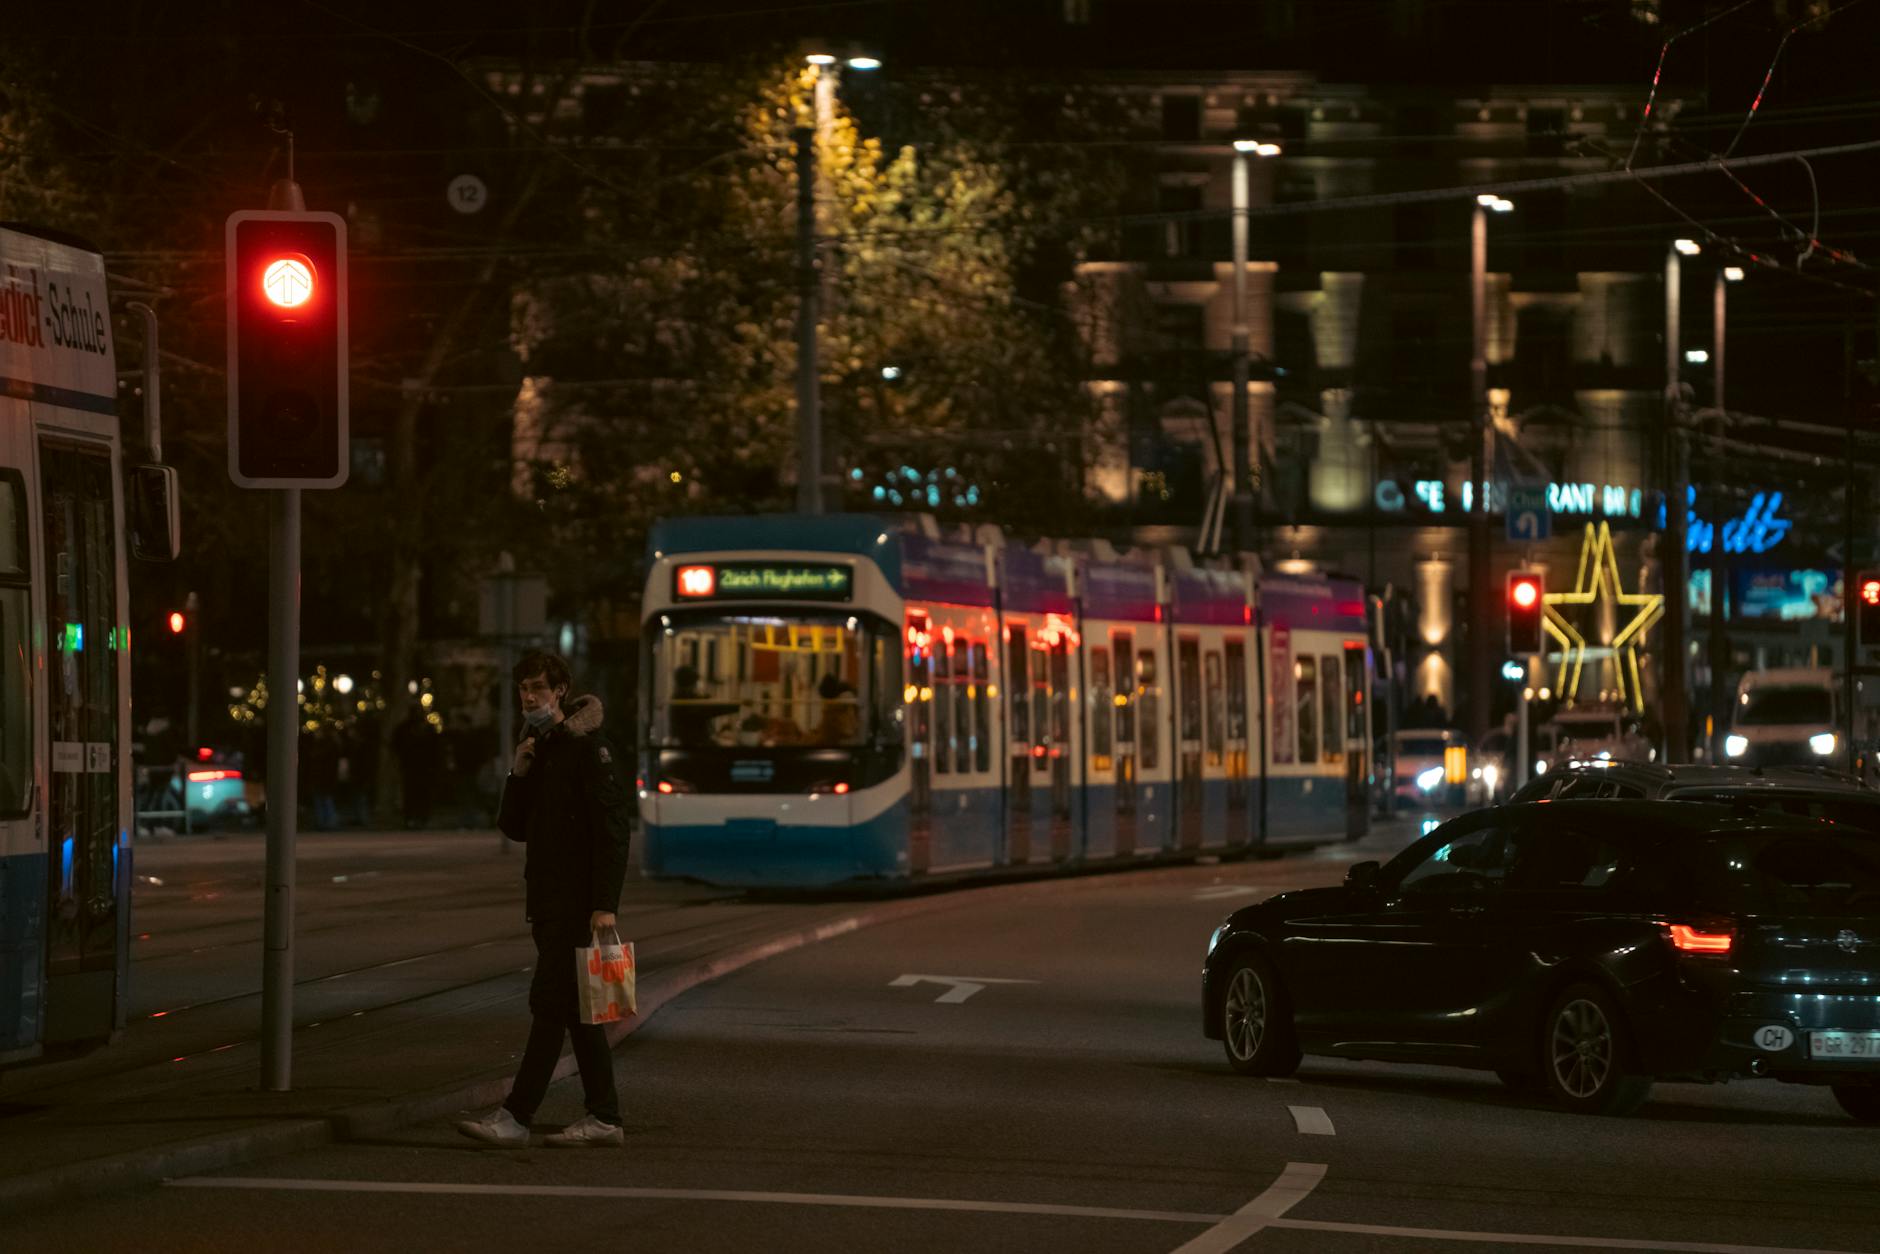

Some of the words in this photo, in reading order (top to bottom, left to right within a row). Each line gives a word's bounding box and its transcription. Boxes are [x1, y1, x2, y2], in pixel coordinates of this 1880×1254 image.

[457, 184, 479, 202] 12
[682, 569, 711, 593] 10
[1763, 1029, 1785, 1048] CH
